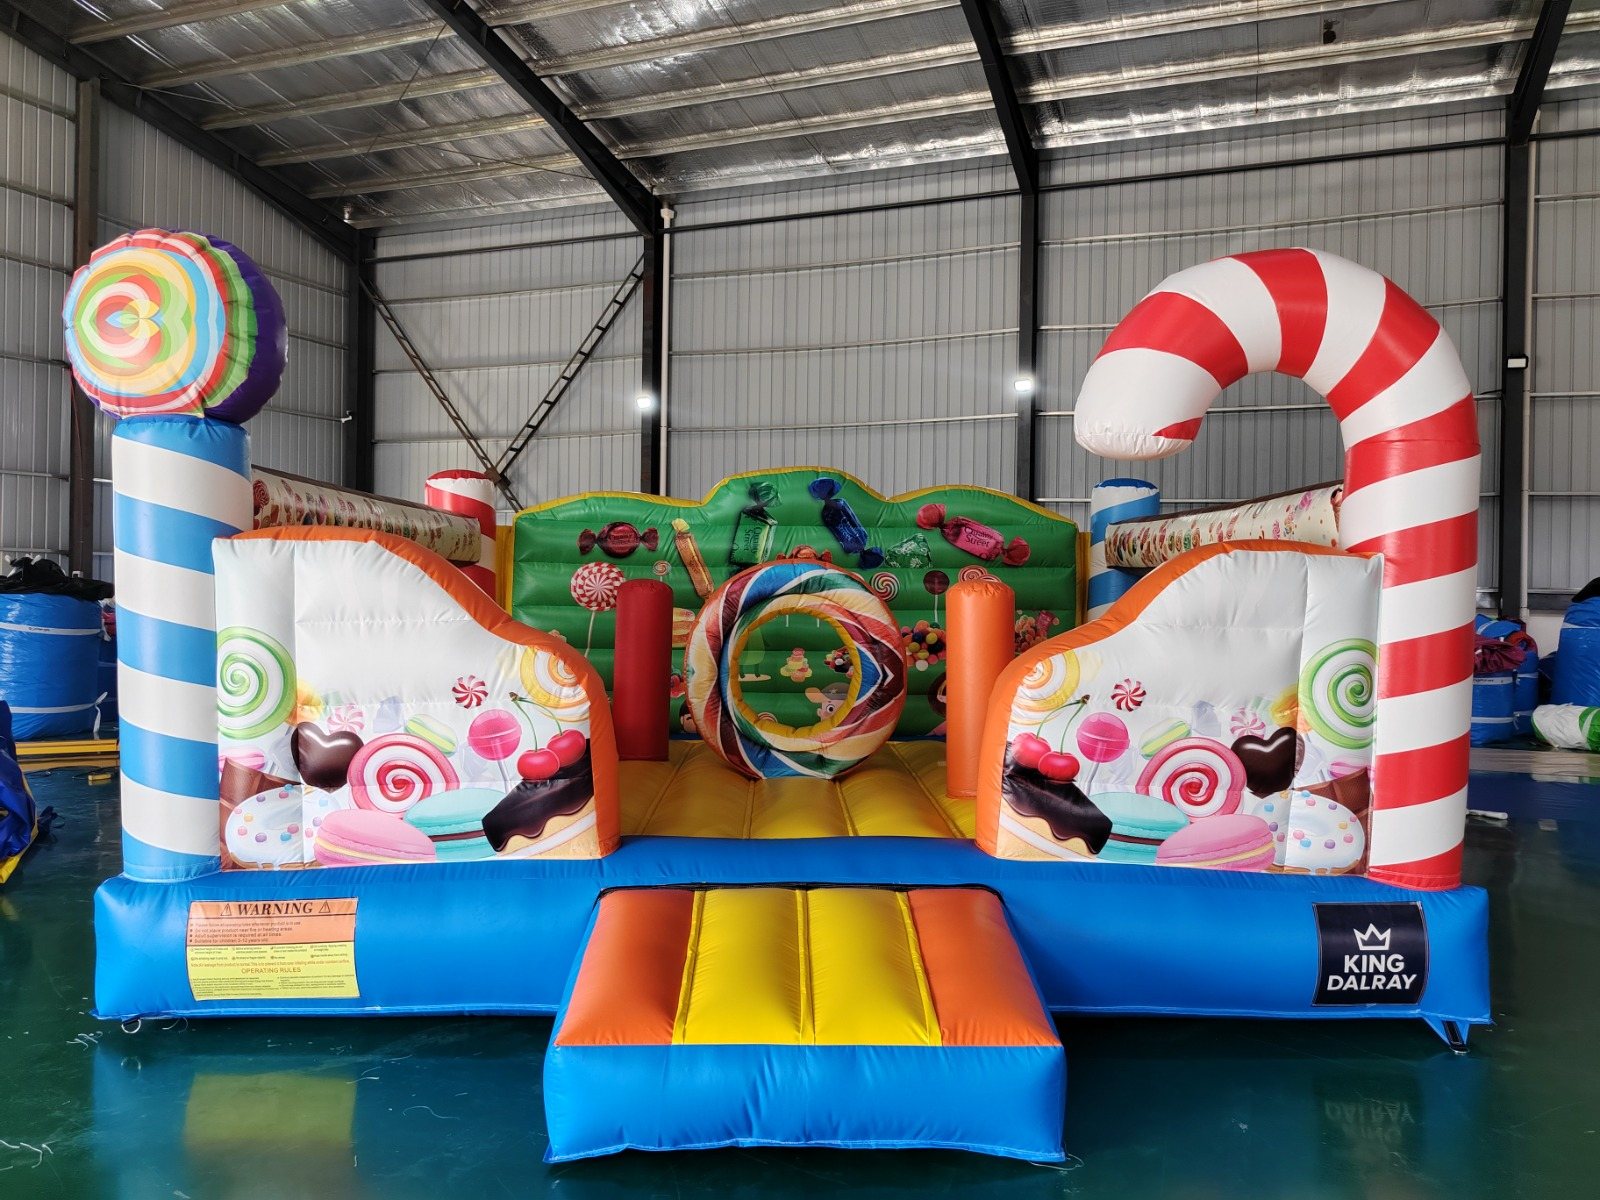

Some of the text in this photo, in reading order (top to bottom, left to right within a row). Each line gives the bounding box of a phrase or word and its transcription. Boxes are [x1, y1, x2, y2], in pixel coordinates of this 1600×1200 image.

[238, 902, 312, 915] WARNING
[1344, 954, 1405, 973] KING
[1327, 974, 1417, 990] DALRAY
